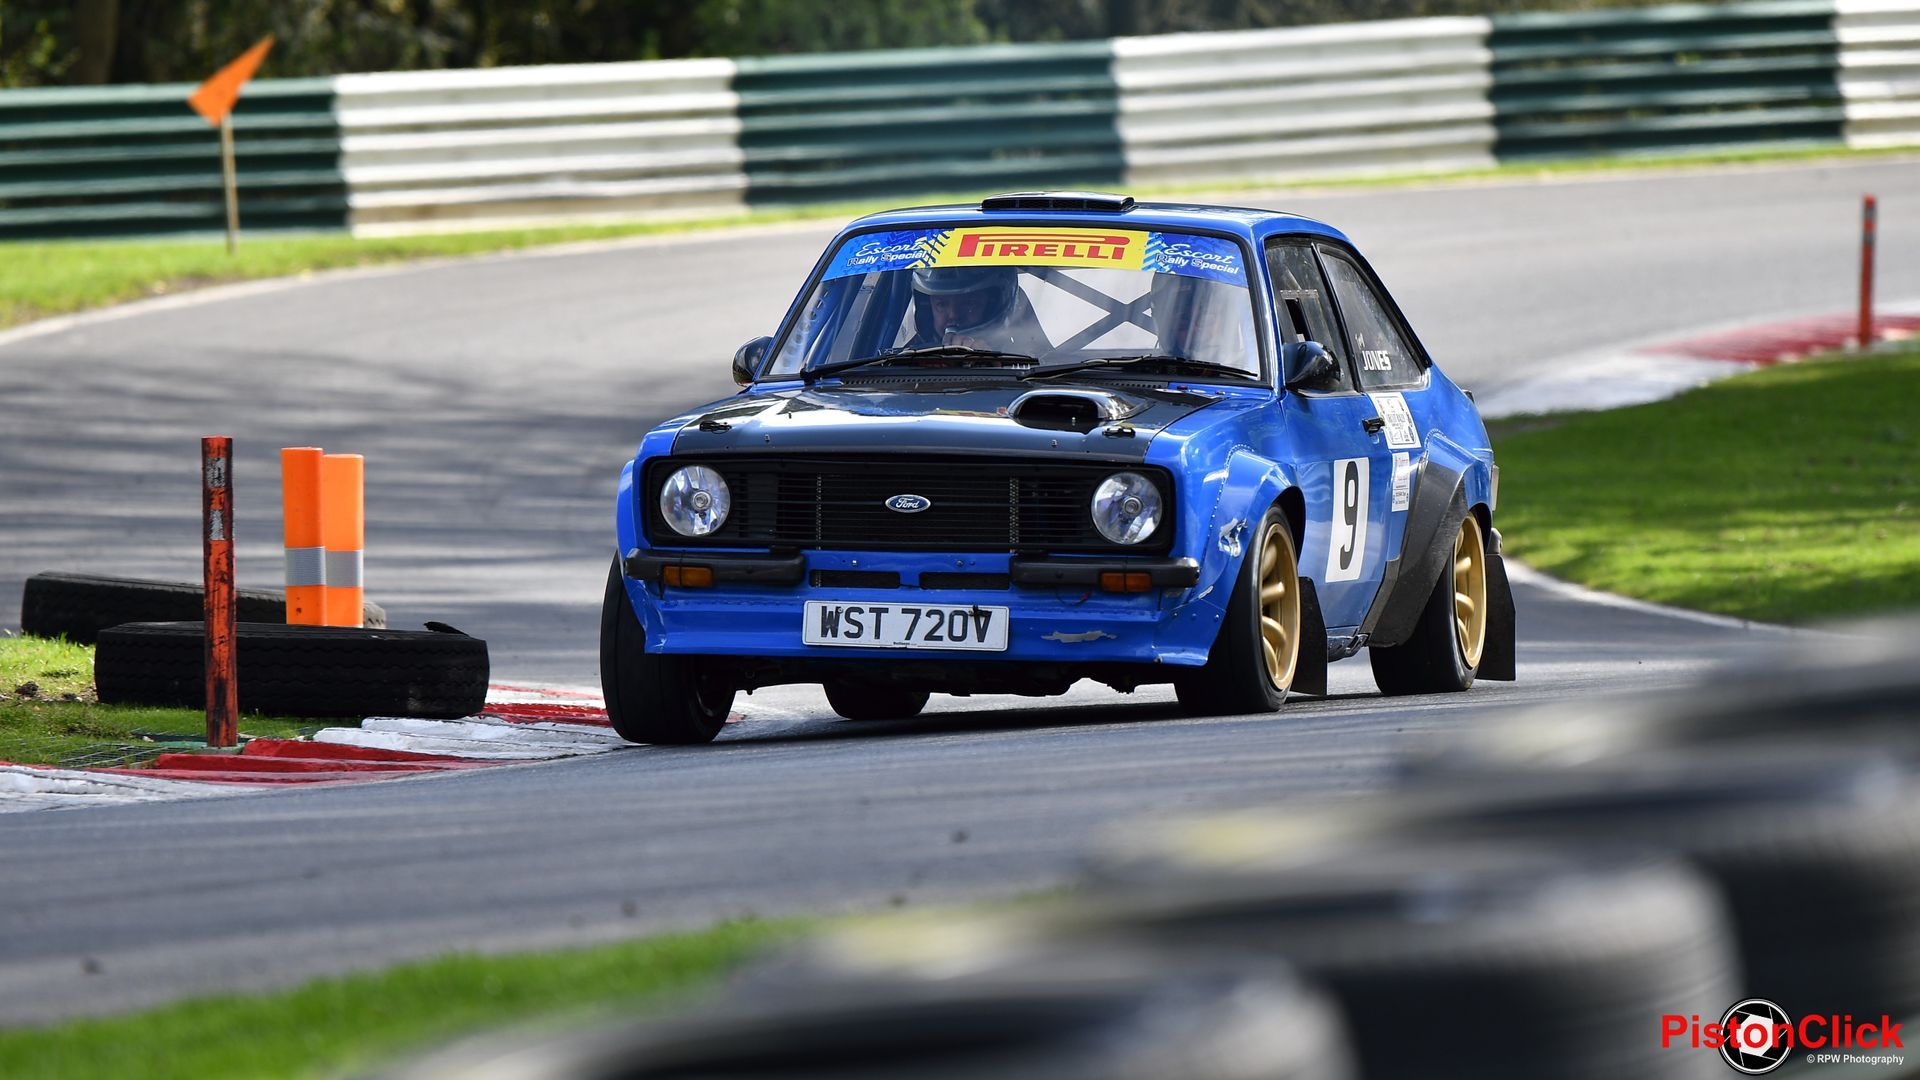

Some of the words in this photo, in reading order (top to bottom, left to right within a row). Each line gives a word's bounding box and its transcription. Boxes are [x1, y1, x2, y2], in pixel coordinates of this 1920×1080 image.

[856, 240, 923, 257] Escort
[957, 233, 1130, 260] PIRELLI
[1165, 243, 1236, 264] Escort
[847, 255, 878, 267] Rally
[881, 250, 926, 262] Special
[1156, 253, 1189, 267] Rally
[1192, 258, 1240, 275] Special
[1361, 350, 1392, 370] JONES
[895, 497, 920, 509] Ford
[1340, 461, 1359, 570] 9
[820, 605, 889, 640] WST
[901, 607, 992, 643] 720V
